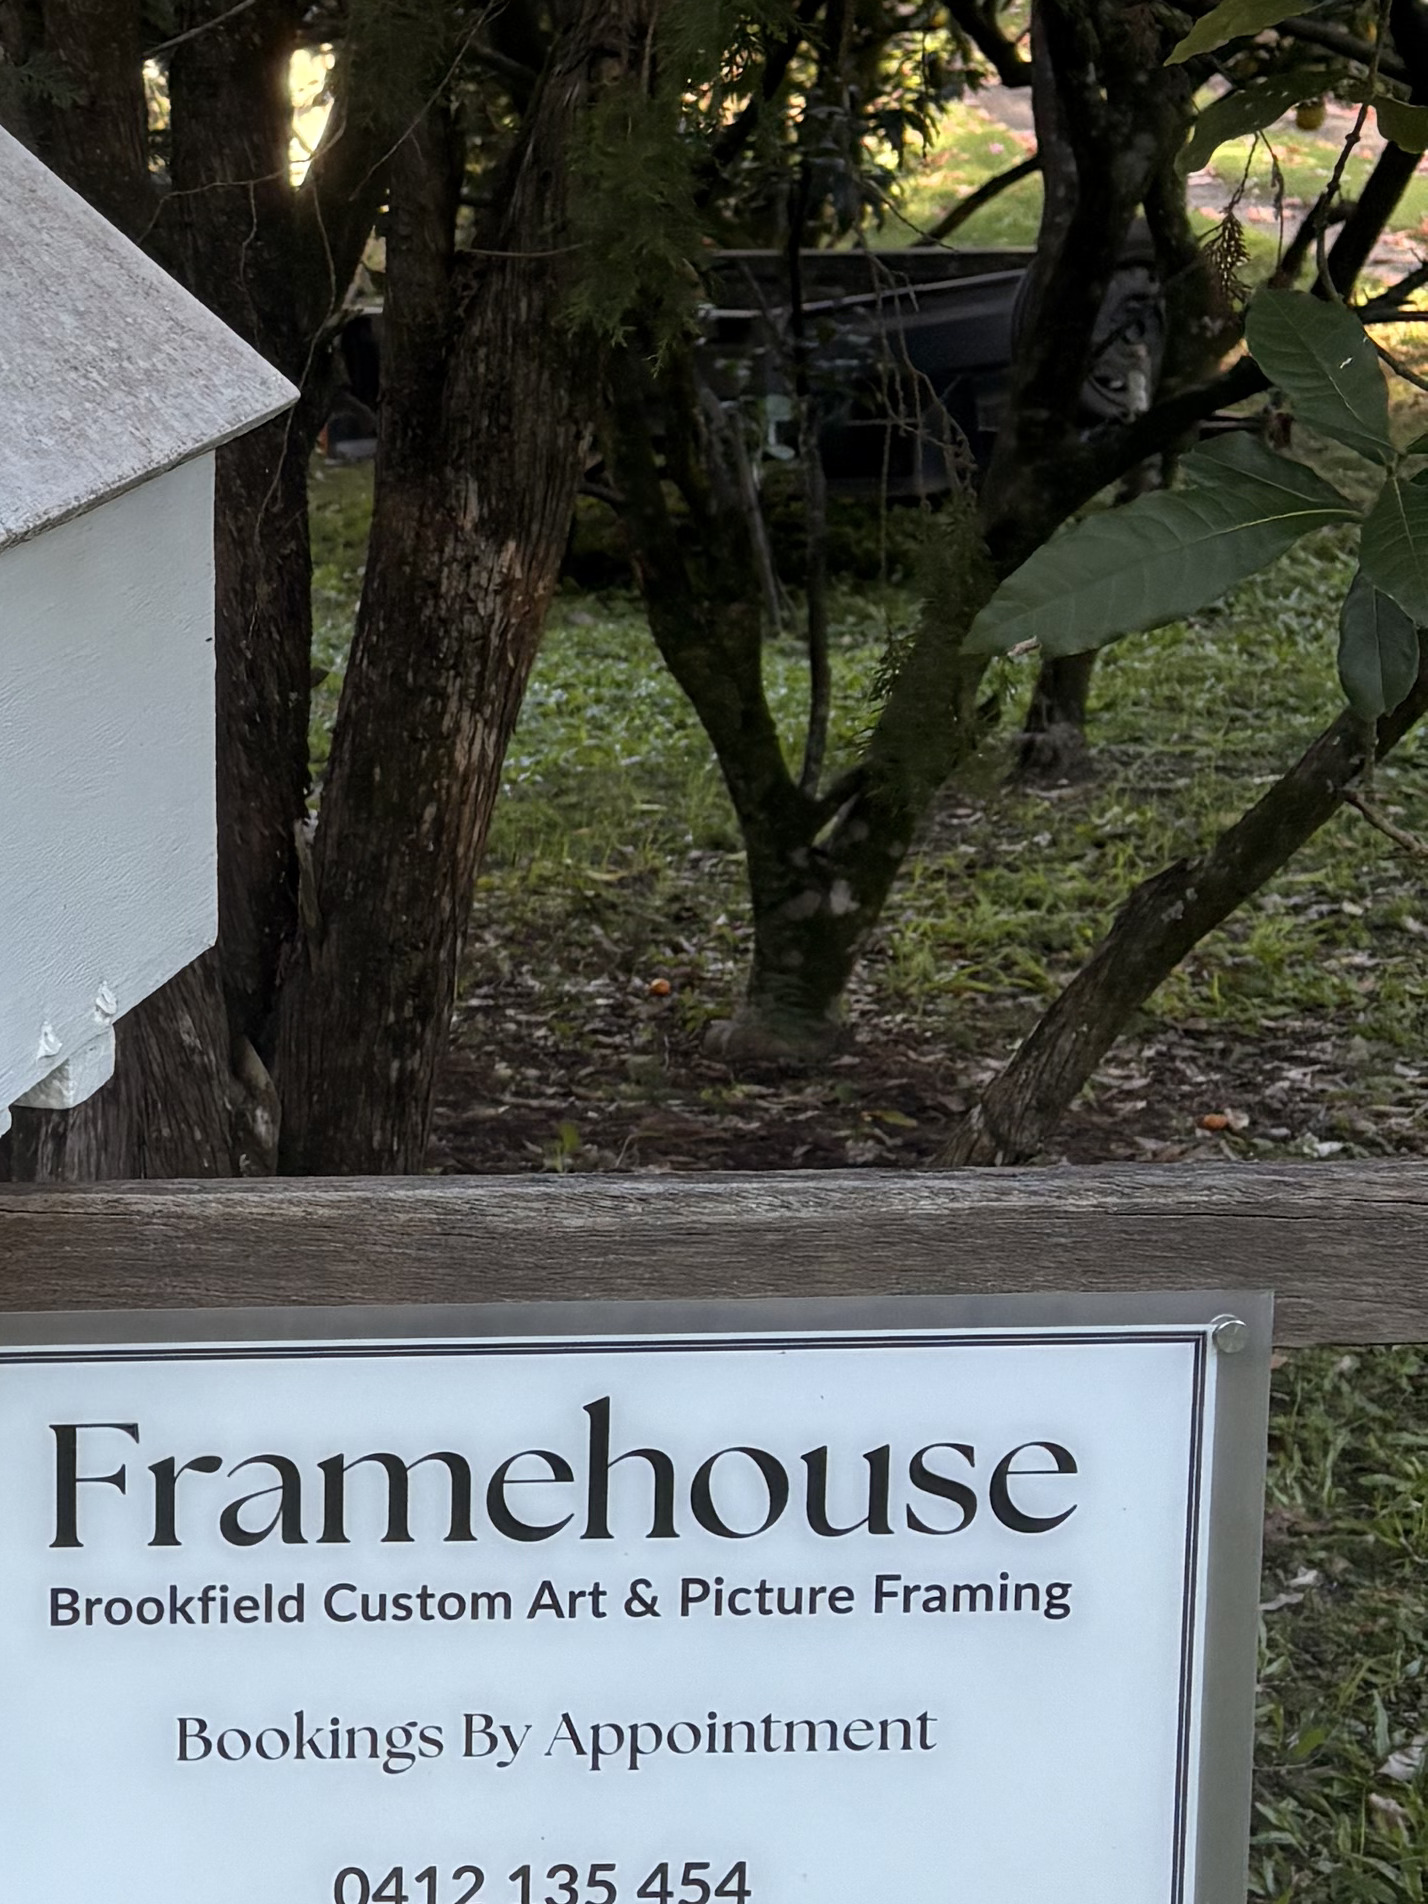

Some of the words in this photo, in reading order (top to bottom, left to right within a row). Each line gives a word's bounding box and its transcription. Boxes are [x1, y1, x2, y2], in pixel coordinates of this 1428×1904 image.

[48, 1395, 1079, 1548] Framehouse
[49, 1582, 306, 1627] Brookfield
[323, 1582, 513, 1623] Custom
[526, 1580, 608, 1620] Art
[623, 1577, 662, 1618] &
[679, 1576, 856, 1617] Picture
[873, 1571, 1073, 1620] Framing
[176, 1709, 445, 1775] Bookings
[461, 1713, 534, 1768] By
[544, 1707, 938, 1771] Appointment
